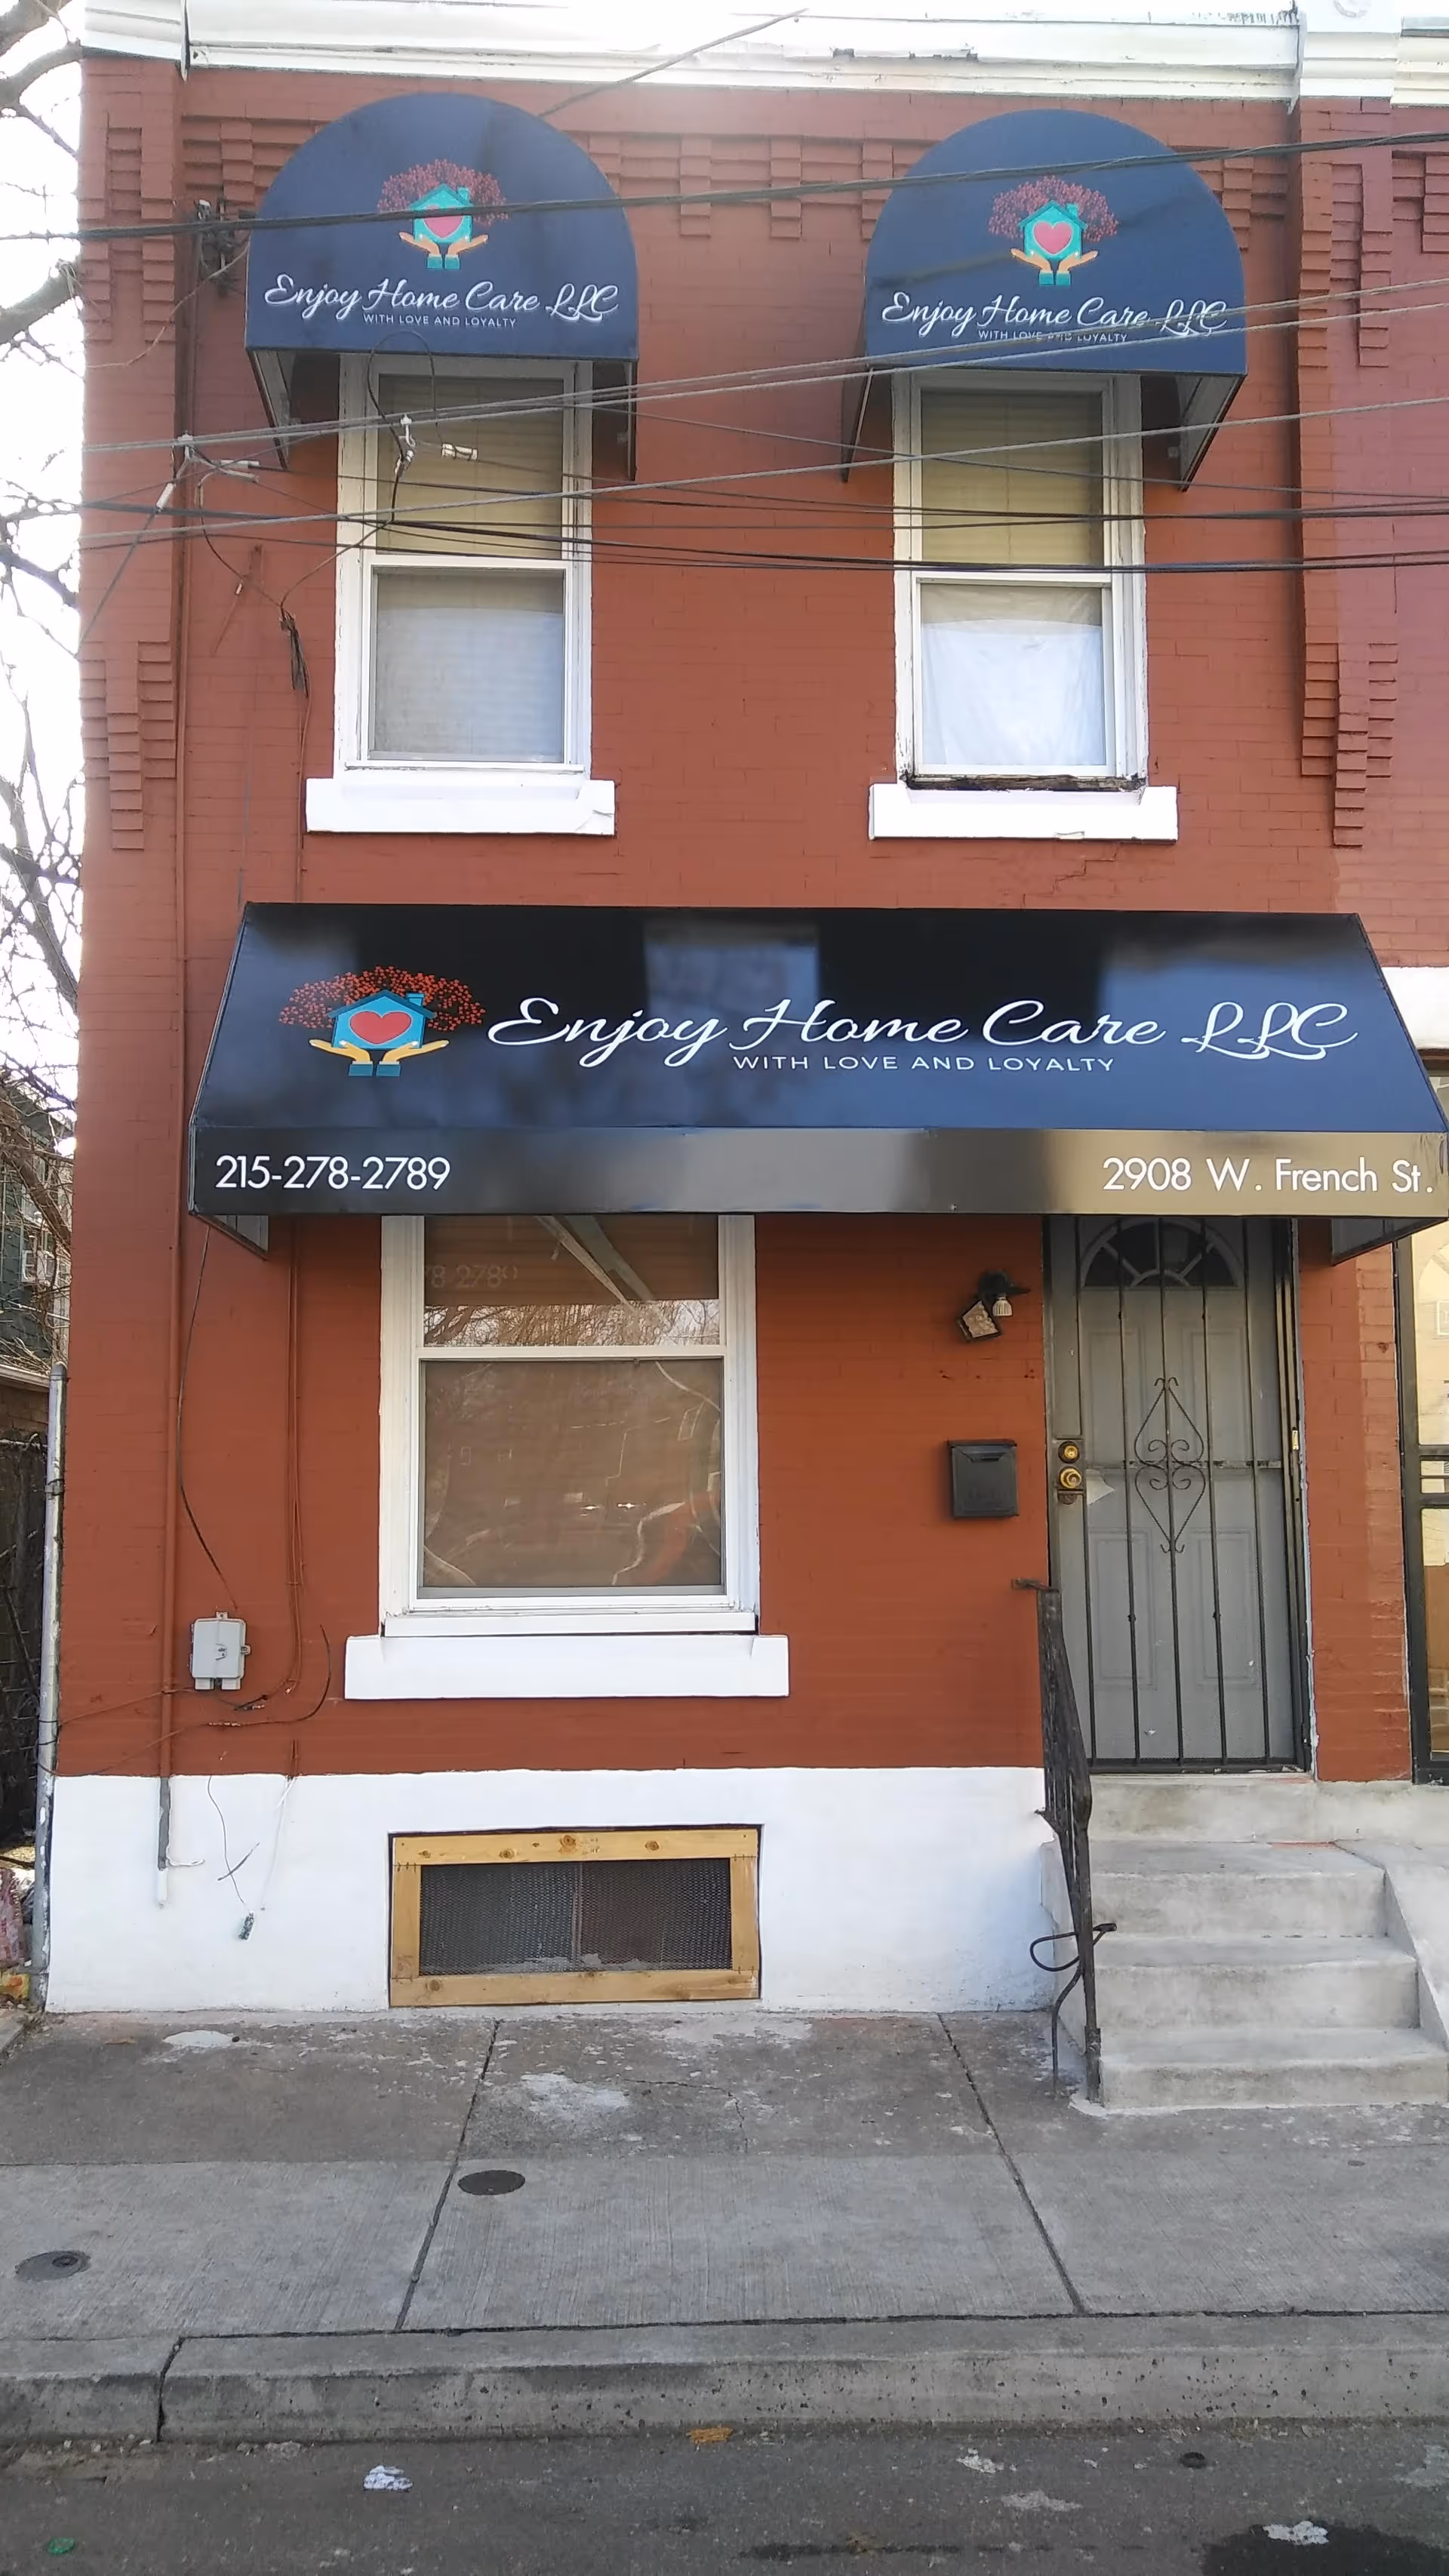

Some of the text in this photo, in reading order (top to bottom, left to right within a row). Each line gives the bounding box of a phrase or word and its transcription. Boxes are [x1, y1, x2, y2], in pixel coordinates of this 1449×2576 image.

[264, 274, 619, 322] Enjoy Home Care LLC
[881, 291, 1228, 338] Enjoy Home Care LLC
[363, 314, 517, 329] WITH LOVE AND LOYALTY
[978, 330, 1008, 340] WITH
[1013, 331, 1042, 340] LOVE
[487, 997, 1358, 1067] Enjoy Home Care LLC
[733, 1056, 1115, 1072] WITH LOVE AND LOYALTY
[215, 1155, 451, 1190] 215-278-2789
[1102, 1156, 1434, 1194] 2908 W. French St.
